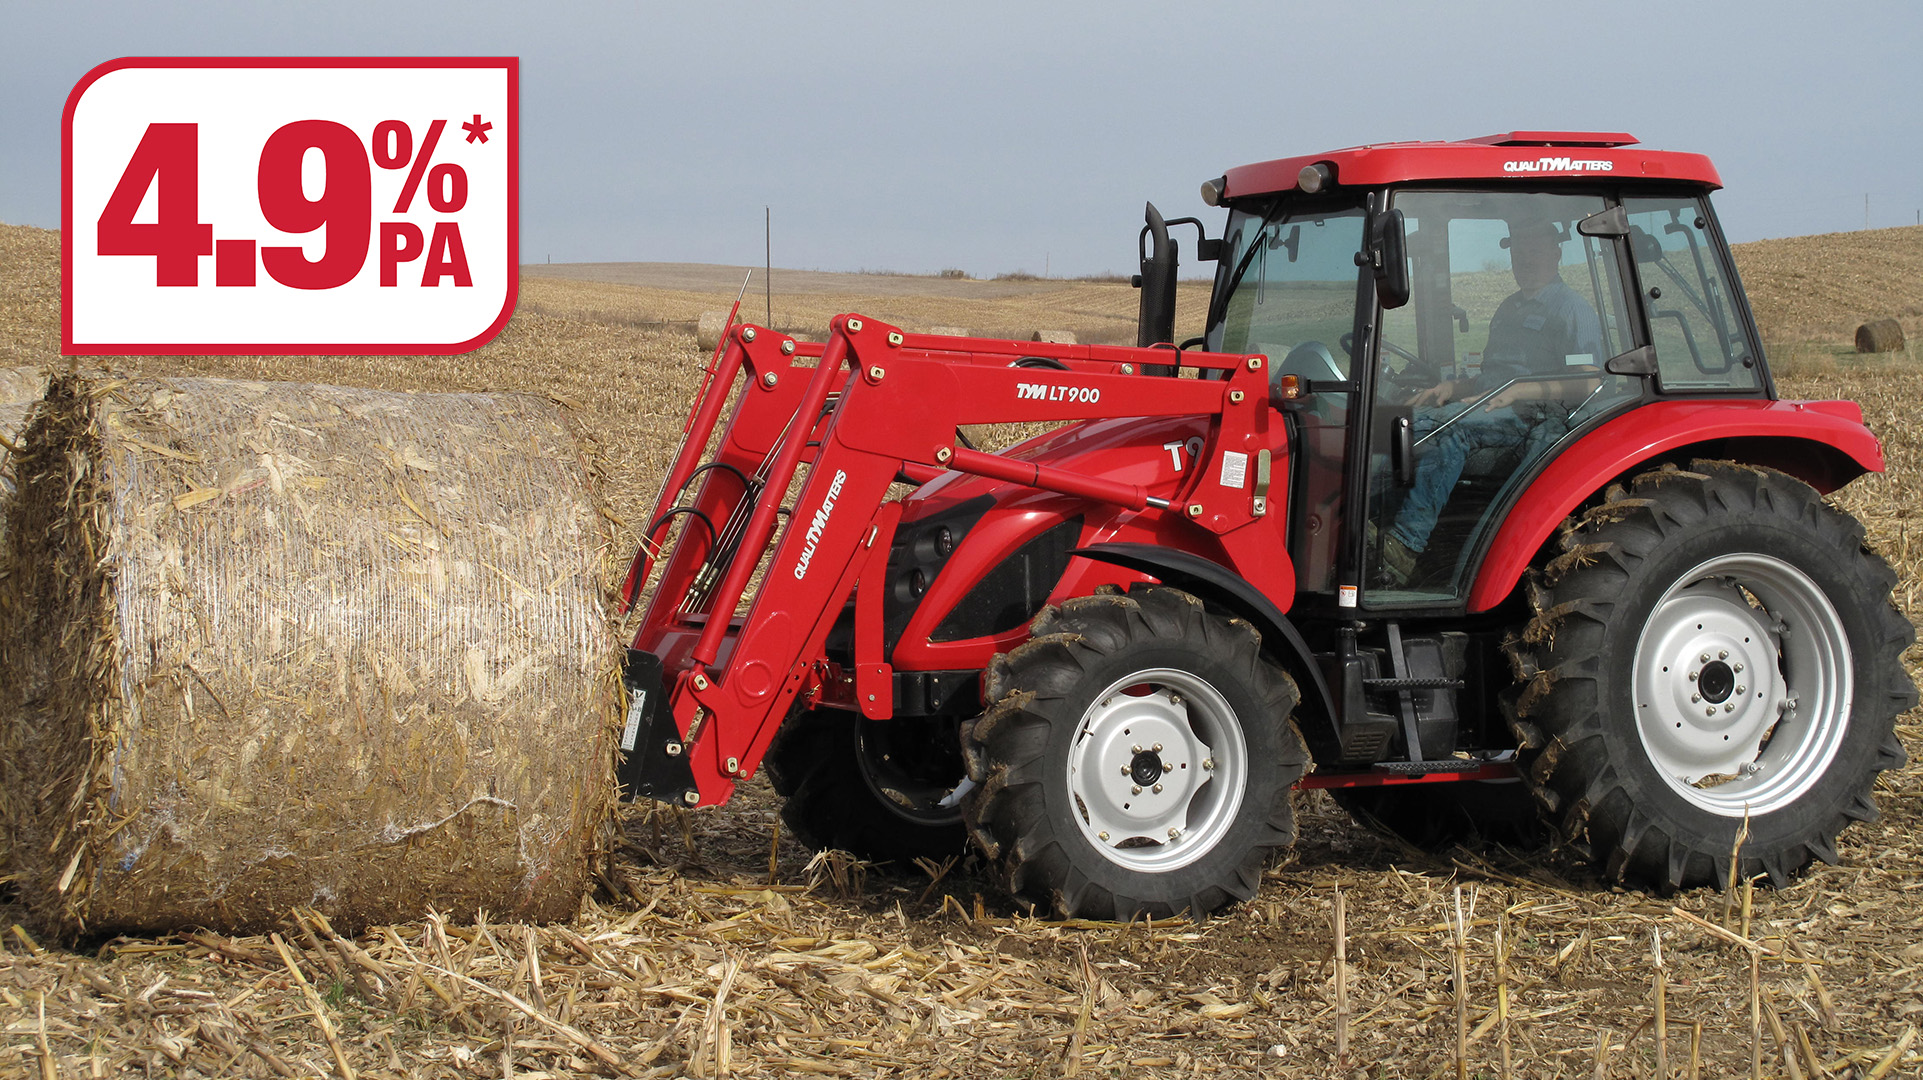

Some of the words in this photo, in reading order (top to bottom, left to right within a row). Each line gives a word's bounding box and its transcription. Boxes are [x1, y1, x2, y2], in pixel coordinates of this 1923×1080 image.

[1503, 157, 1613, 172] QUALITYMATTERS
[1016, 382, 1048, 400] TYM
[1049, 385, 1100, 404] LT900
[794, 469, 847, 580] QUALITYMATTERS
